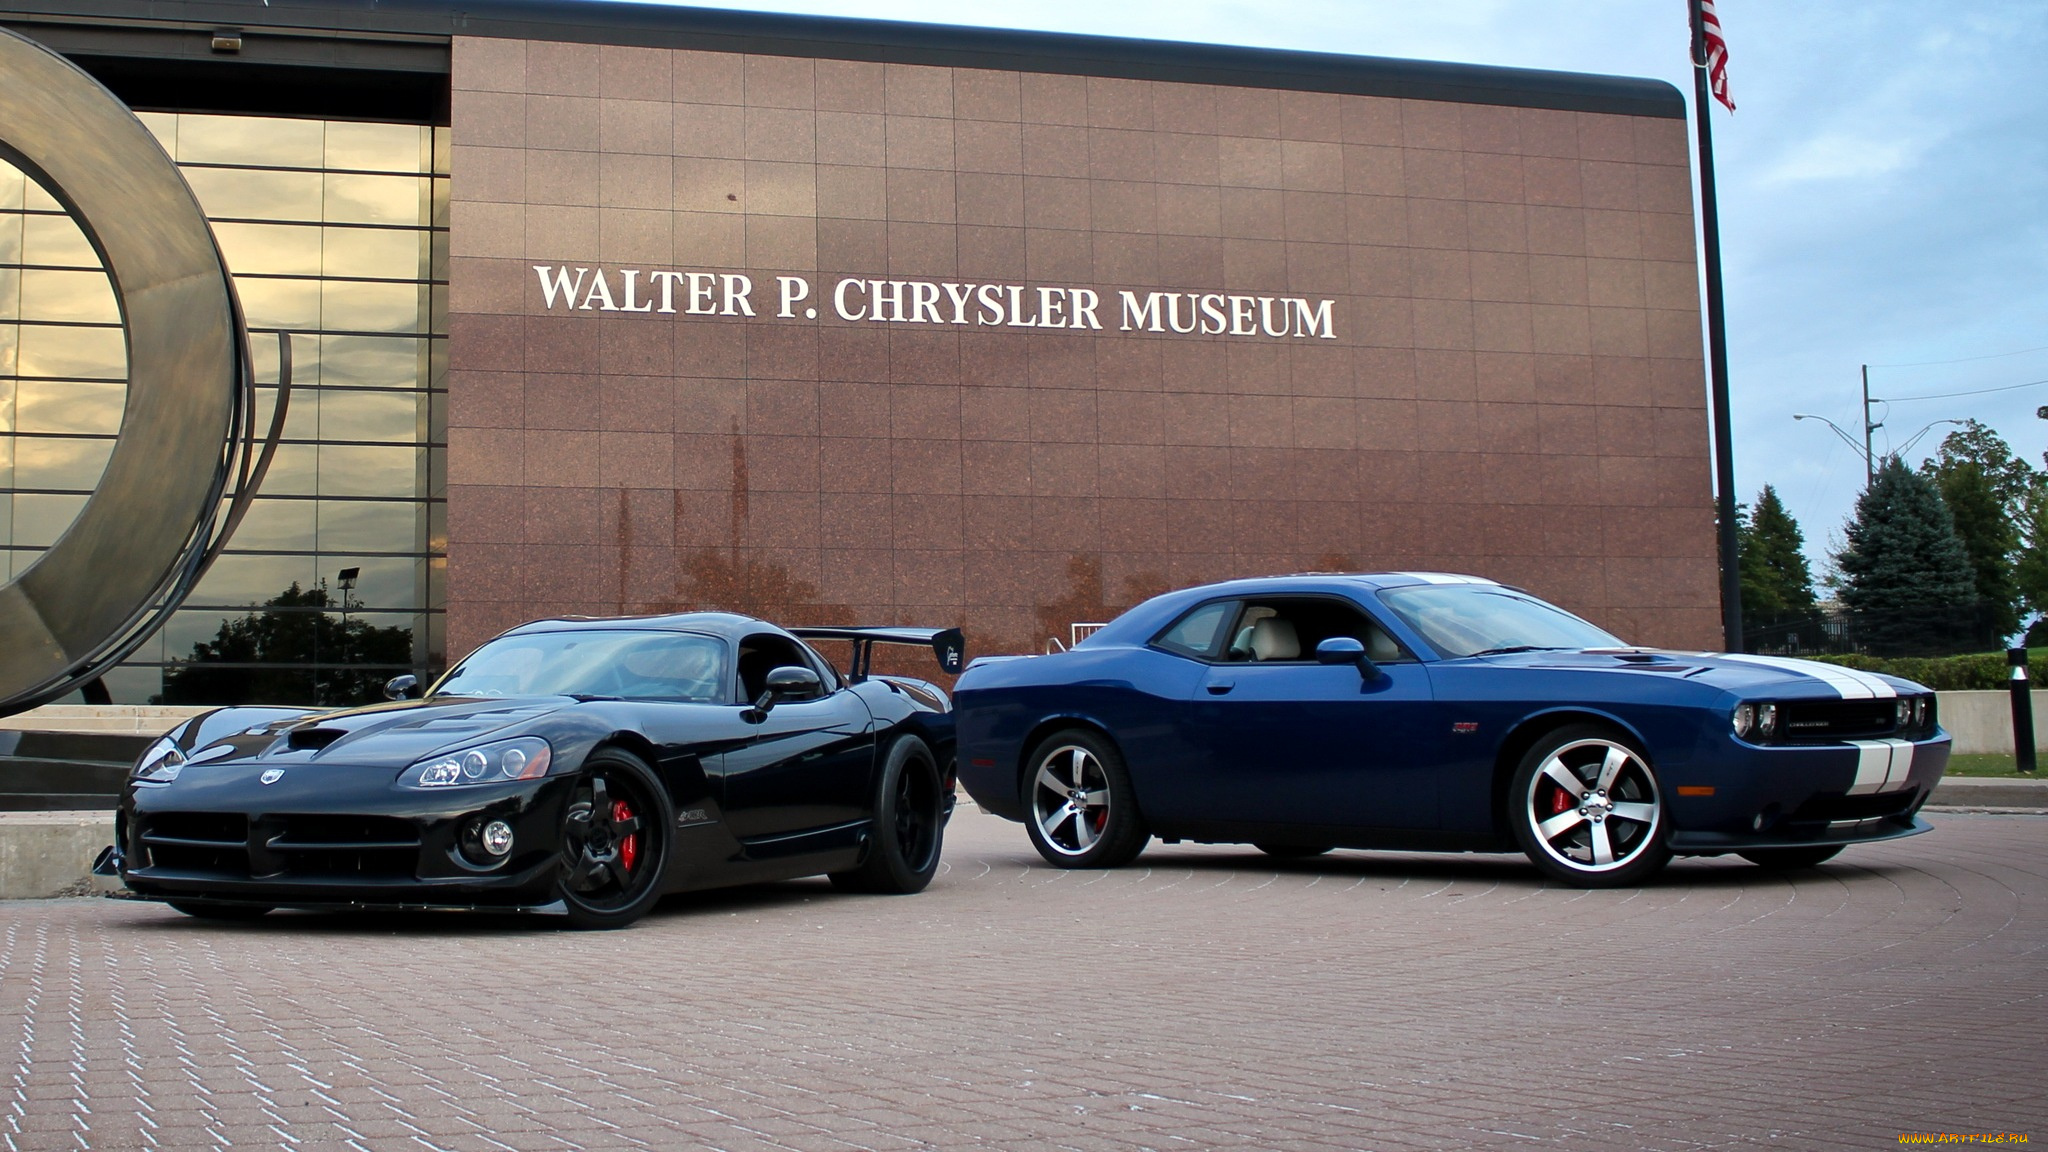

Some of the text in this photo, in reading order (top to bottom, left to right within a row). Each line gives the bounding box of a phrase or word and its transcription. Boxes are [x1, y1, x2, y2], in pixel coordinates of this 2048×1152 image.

[532, 265, 1338, 339] WALTER P. CHRYSLER MUSEUM
